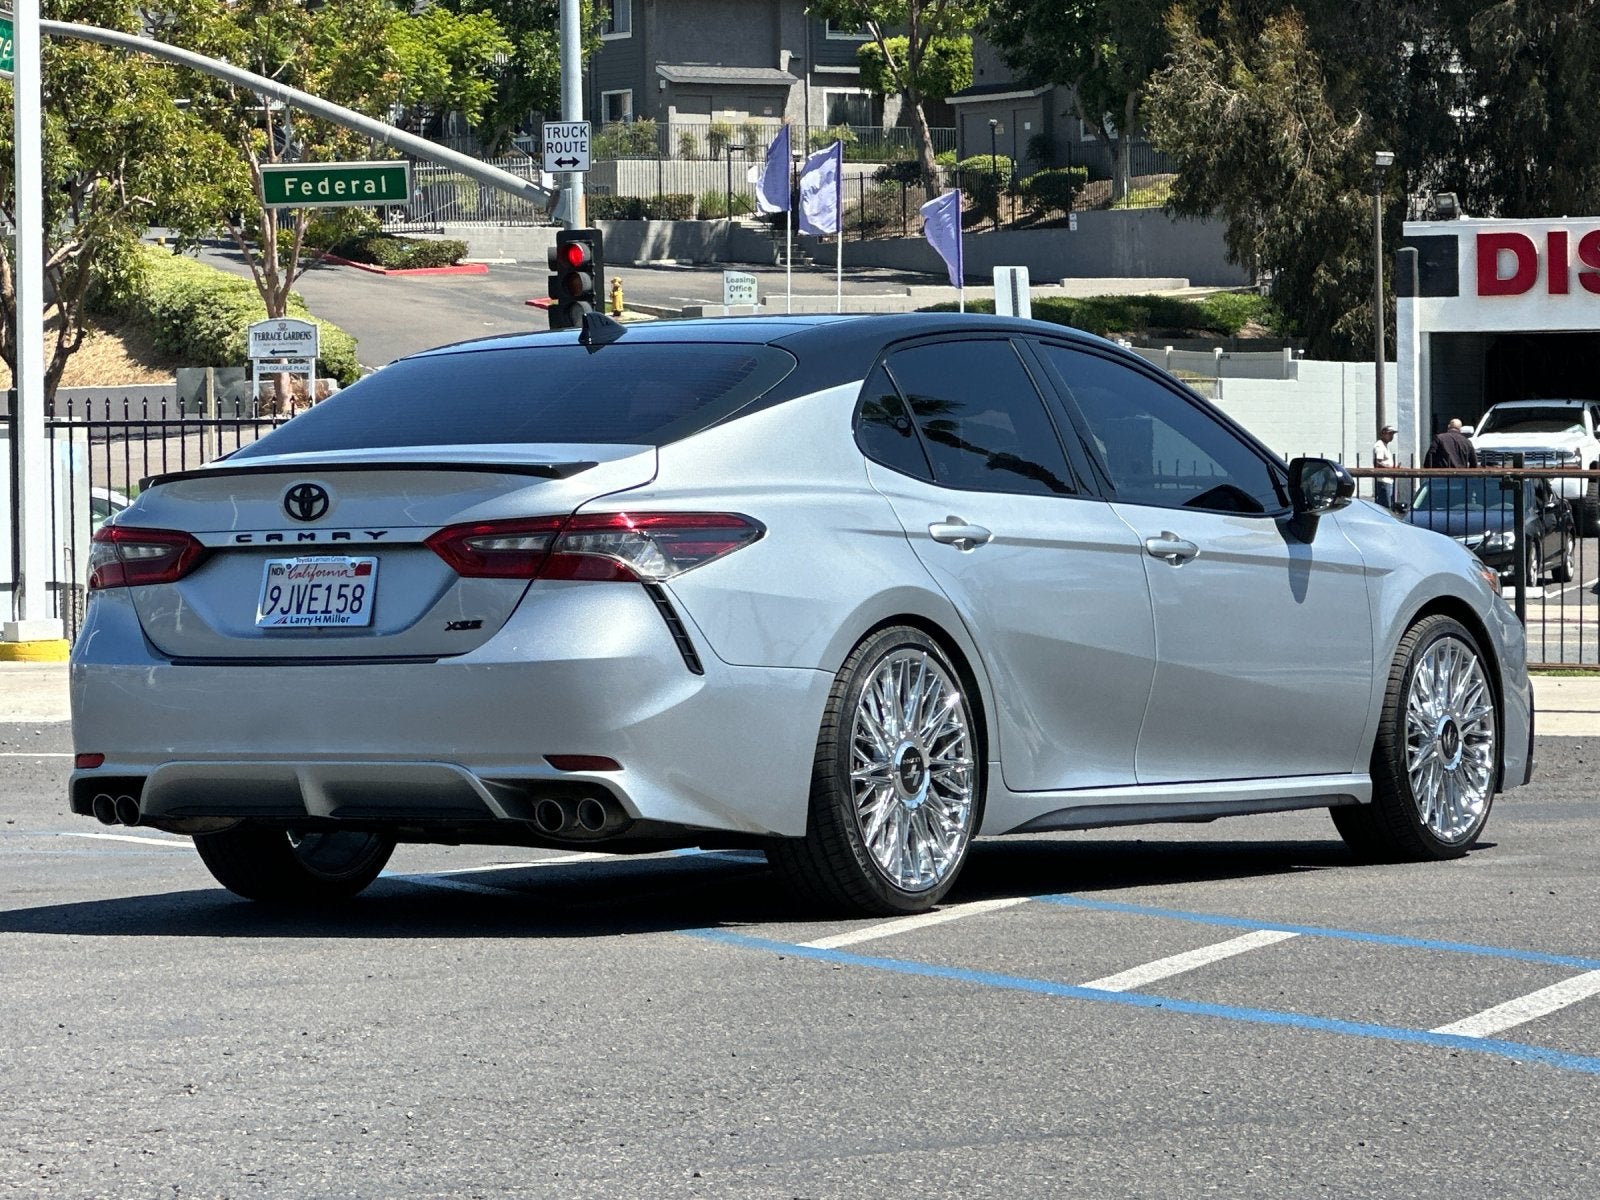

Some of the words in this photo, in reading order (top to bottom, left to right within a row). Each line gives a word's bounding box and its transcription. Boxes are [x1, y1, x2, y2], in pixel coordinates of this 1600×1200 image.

[545, 126, 587, 139] TRUCK
[546, 140, 587, 154] ROUTE
[284, 175, 387, 196] Federal
[726, 276, 756, 284] Leasing
[254, 331, 282, 341] TERRACE
[283, 331, 312, 340] GARDENS
[235, 530, 388, 543] CAMRY
[271, 567, 285, 576] NOV
[288, 563, 355, 582] California
[266, 584, 365, 615] 9JVE158
[290, 616, 313, 625] Larry
[314, 616, 321, 624] H
[323, 614, 350, 624] Miller
